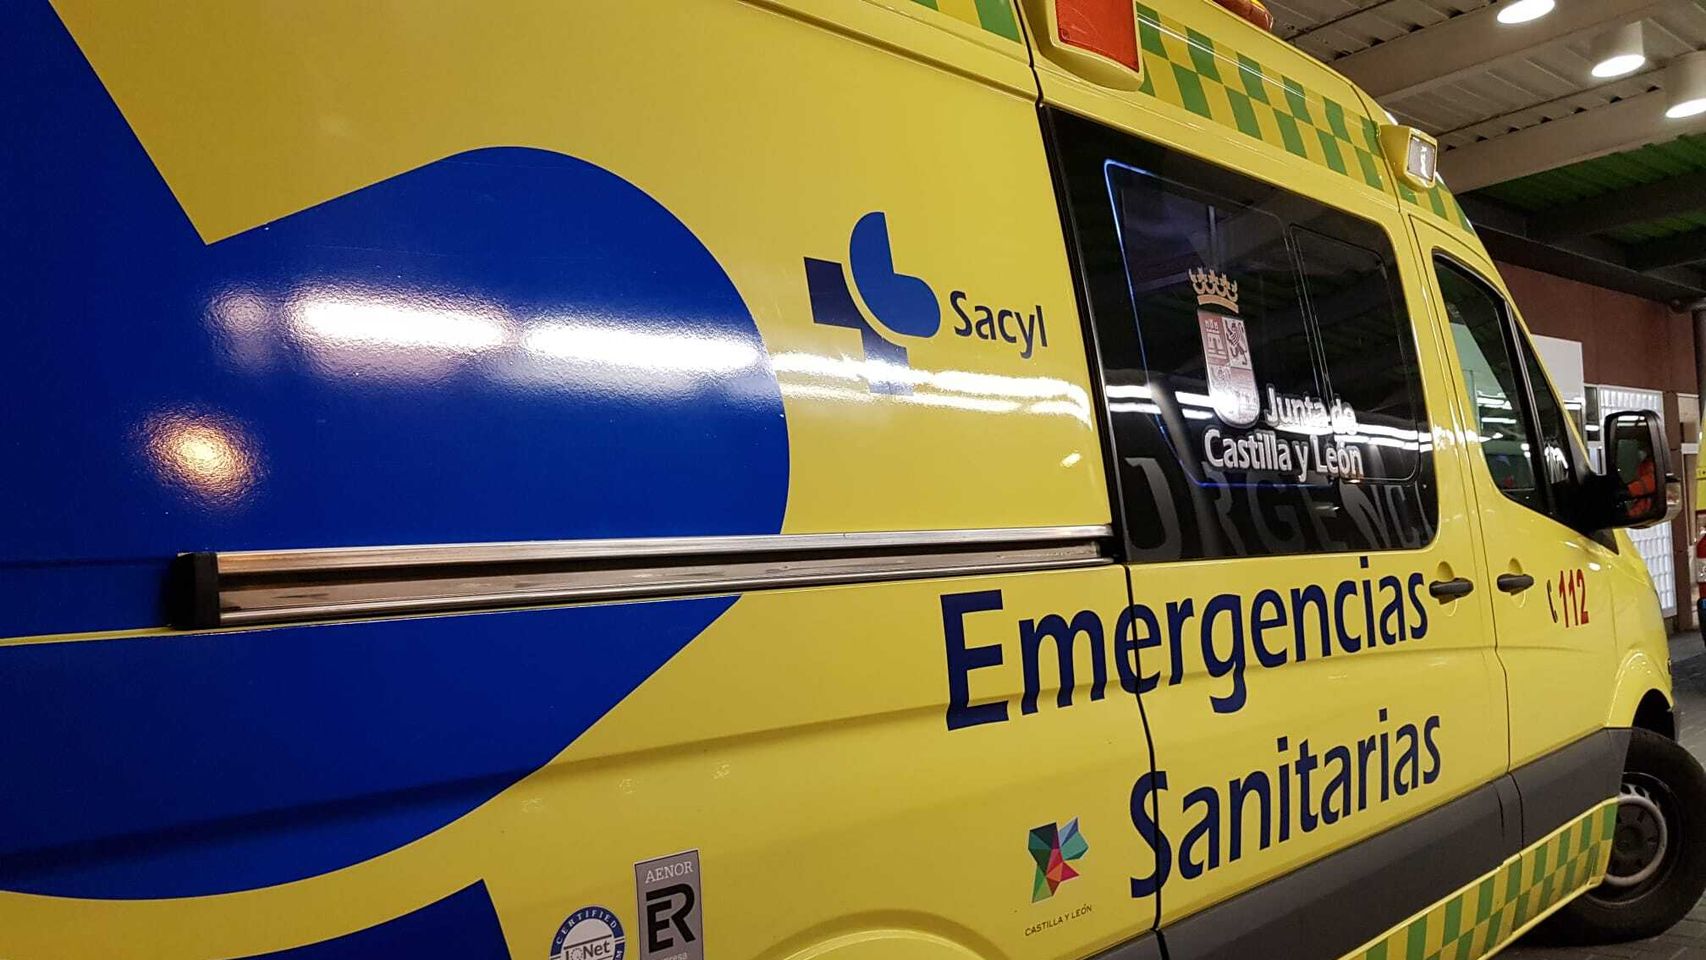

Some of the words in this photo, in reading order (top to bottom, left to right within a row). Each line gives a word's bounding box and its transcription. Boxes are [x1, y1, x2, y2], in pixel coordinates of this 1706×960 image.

[950, 290, 1048, 359] Sacyl
[1264, 386, 1329, 428] Junta
[1331, 398, 1357, 436] de
[1204, 428, 1292, 471] Castilla
[1294, 442, 1308, 483] y
[1309, 433, 1364, 480] León
[1559, 568, 1589, 628] 112
[940, 556, 1430, 731] Emergencias
[1130, 708, 1442, 899] Sanitarias
[645, 861, 693, 884] AENOR
[556, 909, 618, 945] CERTIFIED
[1025, 916, 1064, 936] CASTILLA
[1064, 912, 1070, 921] Y
[1071, 903, 1092, 919] LEÓN
